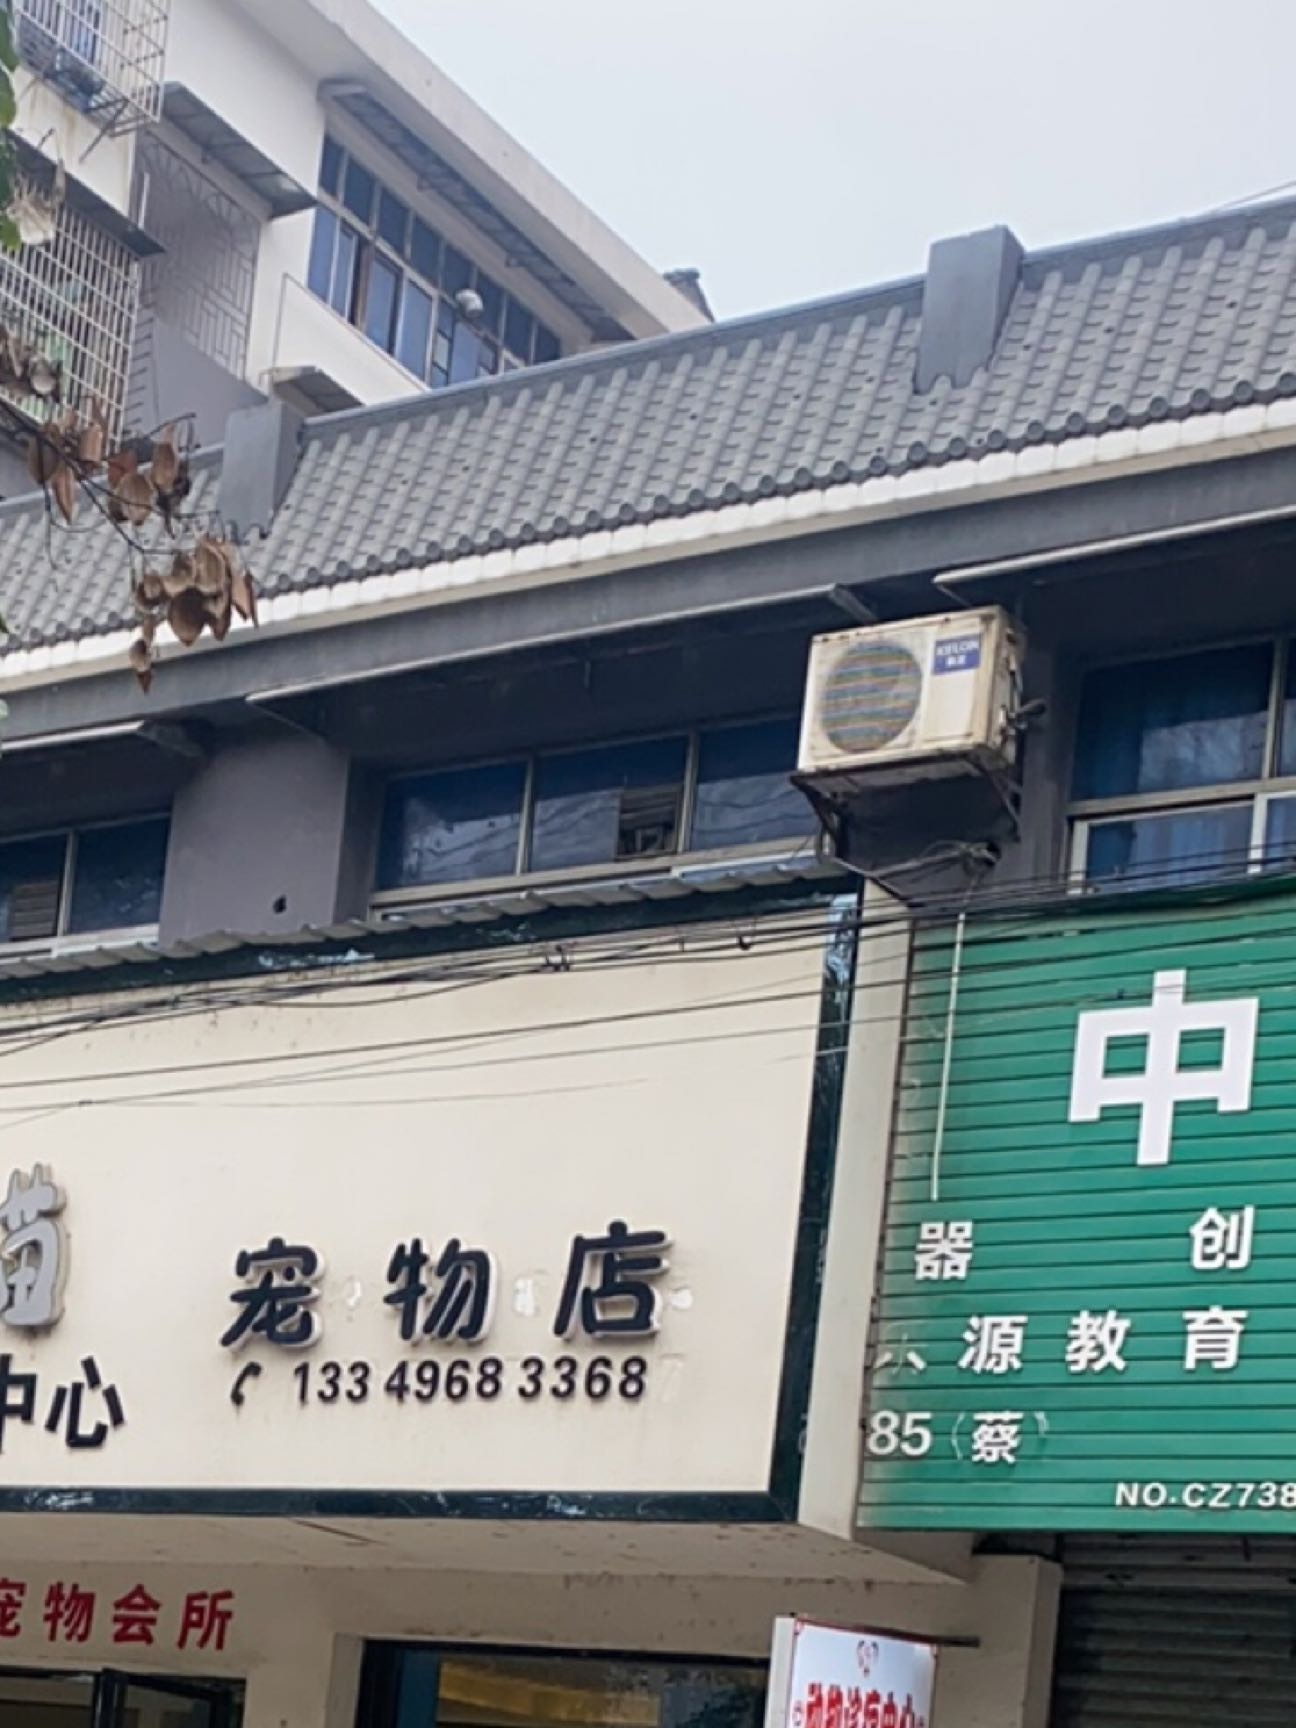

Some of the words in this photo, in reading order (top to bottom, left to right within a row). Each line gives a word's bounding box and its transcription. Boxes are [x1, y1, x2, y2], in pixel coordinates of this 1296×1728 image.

[1068, 969, 1260, 1166] 中
[219, 1219, 670, 1348] 宠物店
[867, 1410, 932, 1456] 85
